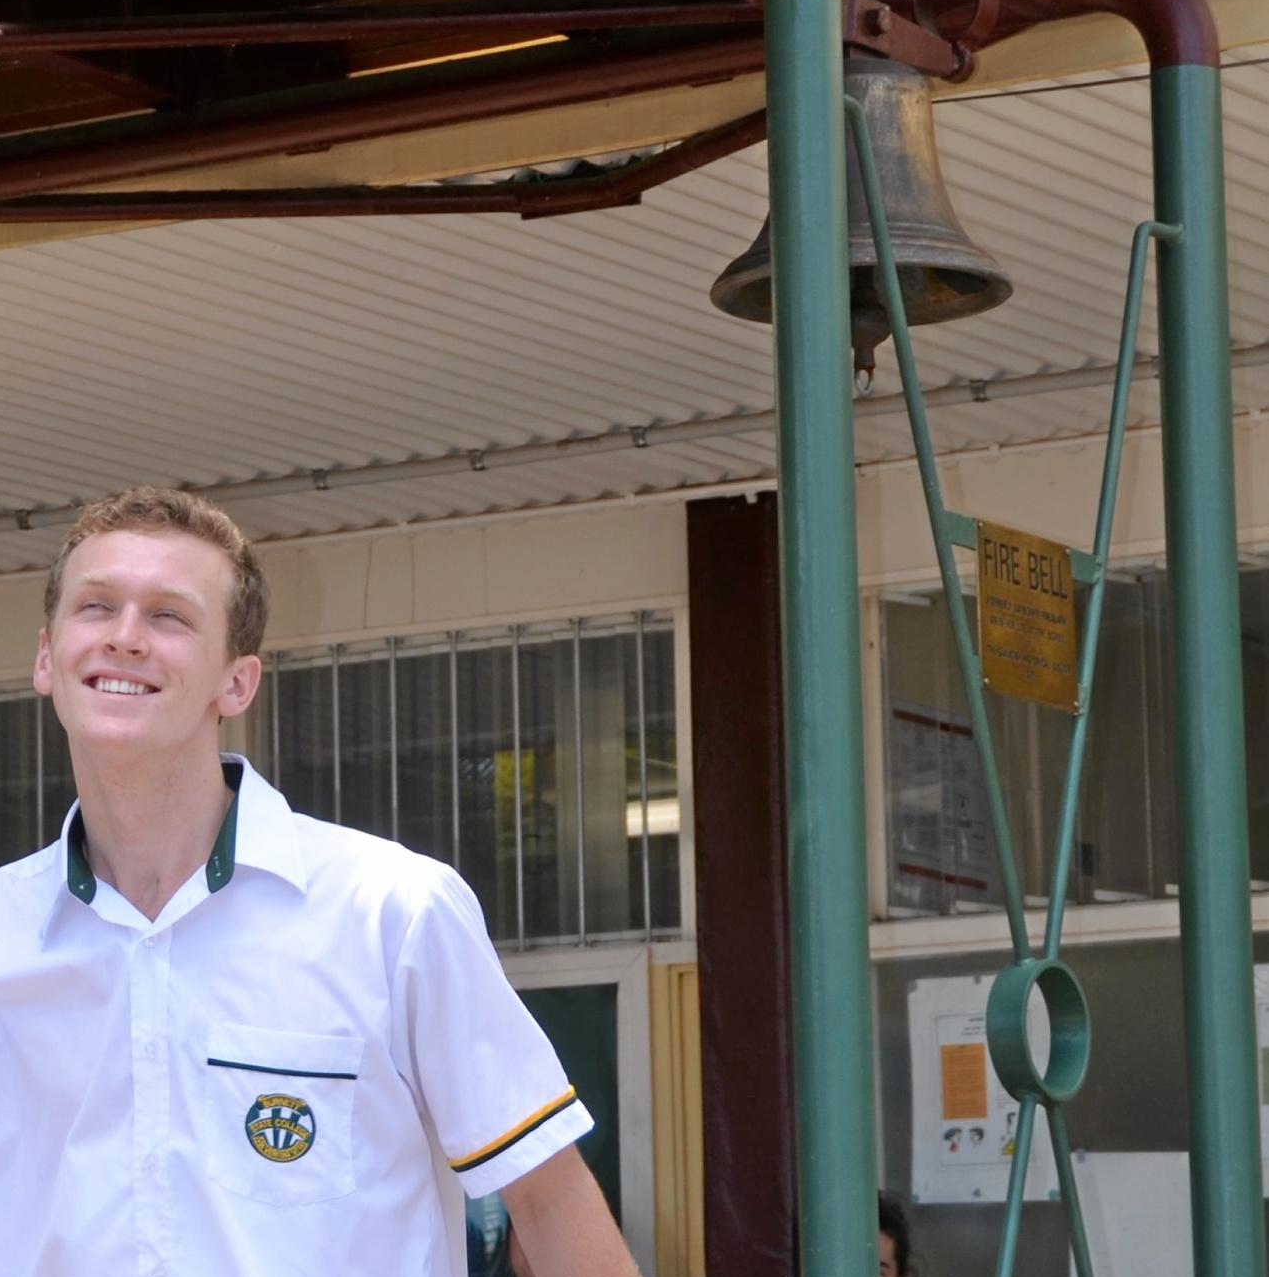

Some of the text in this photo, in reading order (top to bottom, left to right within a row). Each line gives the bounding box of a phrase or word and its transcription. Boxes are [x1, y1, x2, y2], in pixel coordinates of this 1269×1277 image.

[983, 538, 1068, 600] FIRE BELL
[262, 1096, 300, 1109] BURNETT
[250, 1119, 310, 1139] STATE COLLEGE
